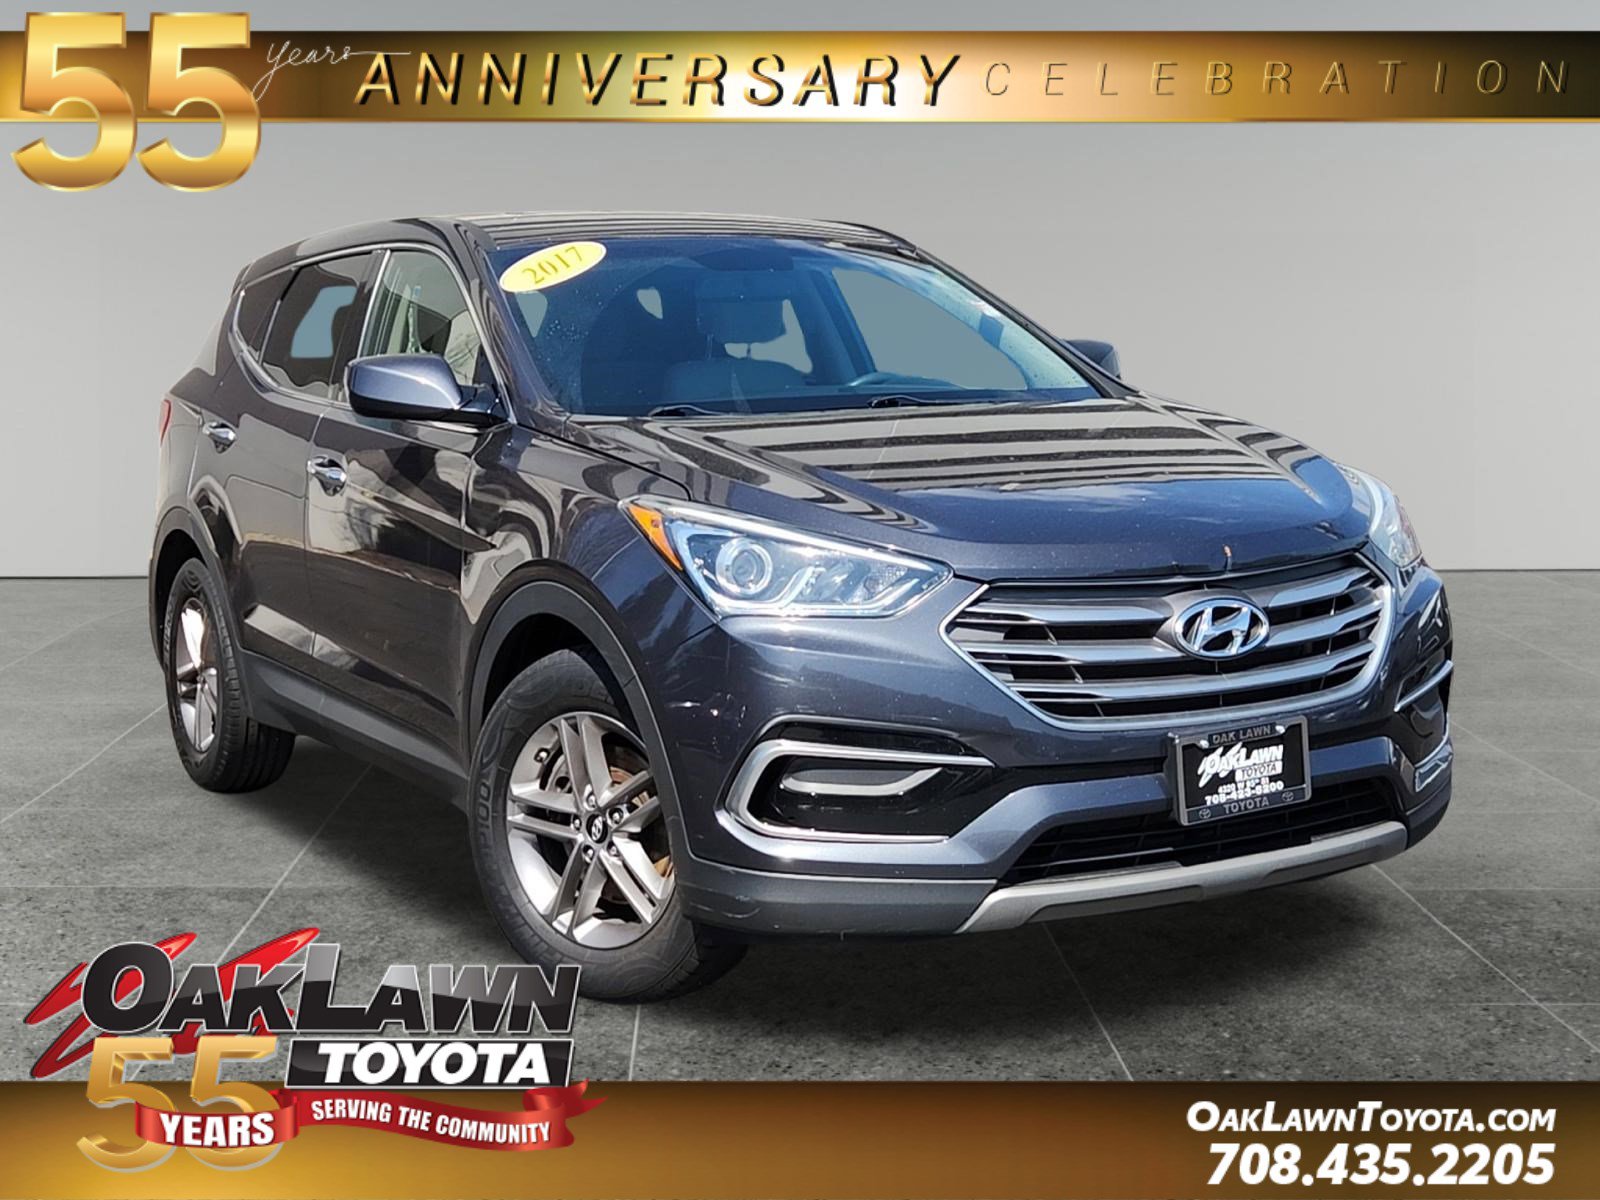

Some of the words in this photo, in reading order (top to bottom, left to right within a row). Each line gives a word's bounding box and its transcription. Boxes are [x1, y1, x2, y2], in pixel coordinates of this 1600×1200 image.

[521, 246, 583, 284] 2017
[1212, 732, 1236, 743] OAK
[1240, 726, 1271, 739] LAWN
[1241, 762, 1278, 778] TOYOTA
[1223, 797, 1269, 814] TOYOTA
